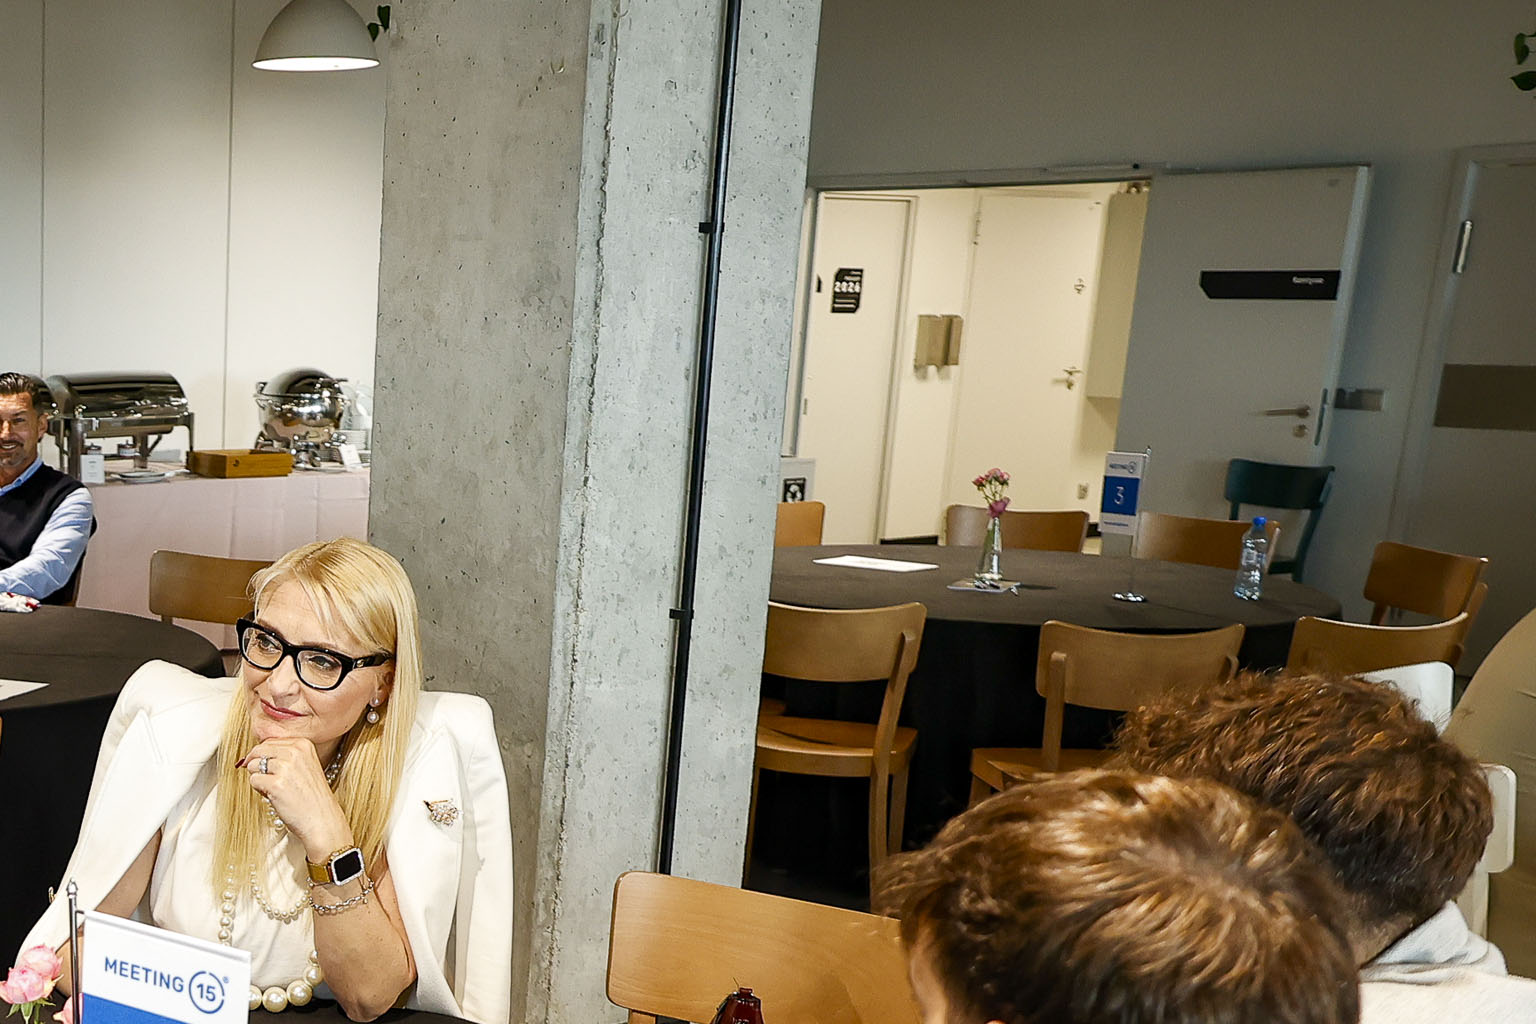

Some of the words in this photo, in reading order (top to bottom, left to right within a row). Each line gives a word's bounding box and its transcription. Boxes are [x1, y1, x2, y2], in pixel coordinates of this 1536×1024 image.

[1114, 486, 1124, 505] 3
[104, 956, 184, 993] MEETING
[196, 983, 216, 1002] 15
